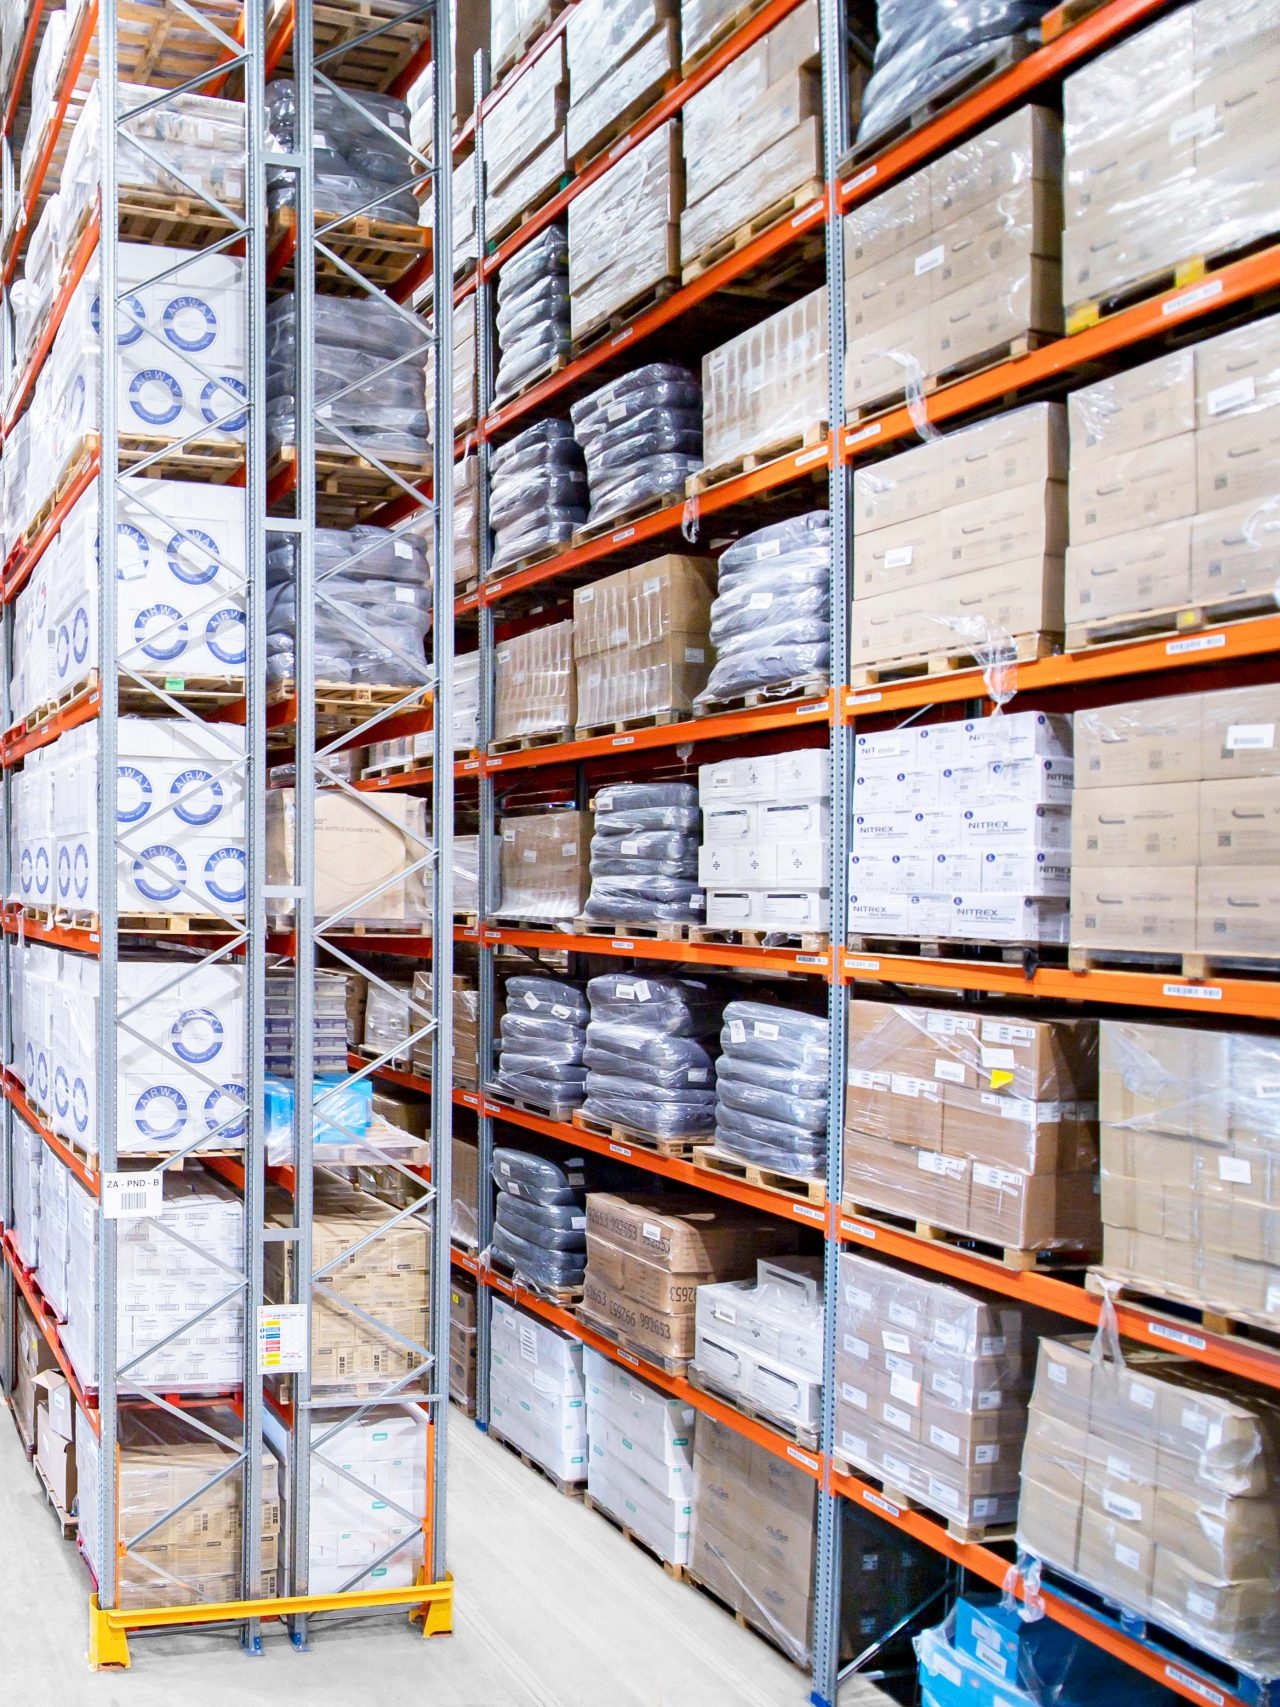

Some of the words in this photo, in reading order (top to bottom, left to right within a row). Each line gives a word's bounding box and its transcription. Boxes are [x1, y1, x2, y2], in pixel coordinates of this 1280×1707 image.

[166, 298, 215, 322] AIRWAY
[133, 370, 182, 397] AIRWAY
[175, 771, 223, 792] AIRWY
[1047, 773, 1073, 782] NITRE
[860, 826, 894, 834] NITREX
[968, 821, 1009, 829] NITREX
[141, 845, 186, 868] IRWAY
[853, 905, 887, 913] NITREX
[957, 908, 998, 916] NITREX
[139, 1087, 186, 1107] AIRWAY
[107, 1180, 119, 1188] ZA
[127, 1179, 146, 1187] PND
[153, 1178, 160, 1187] B
[640, 1312, 671, 1340] 992653
